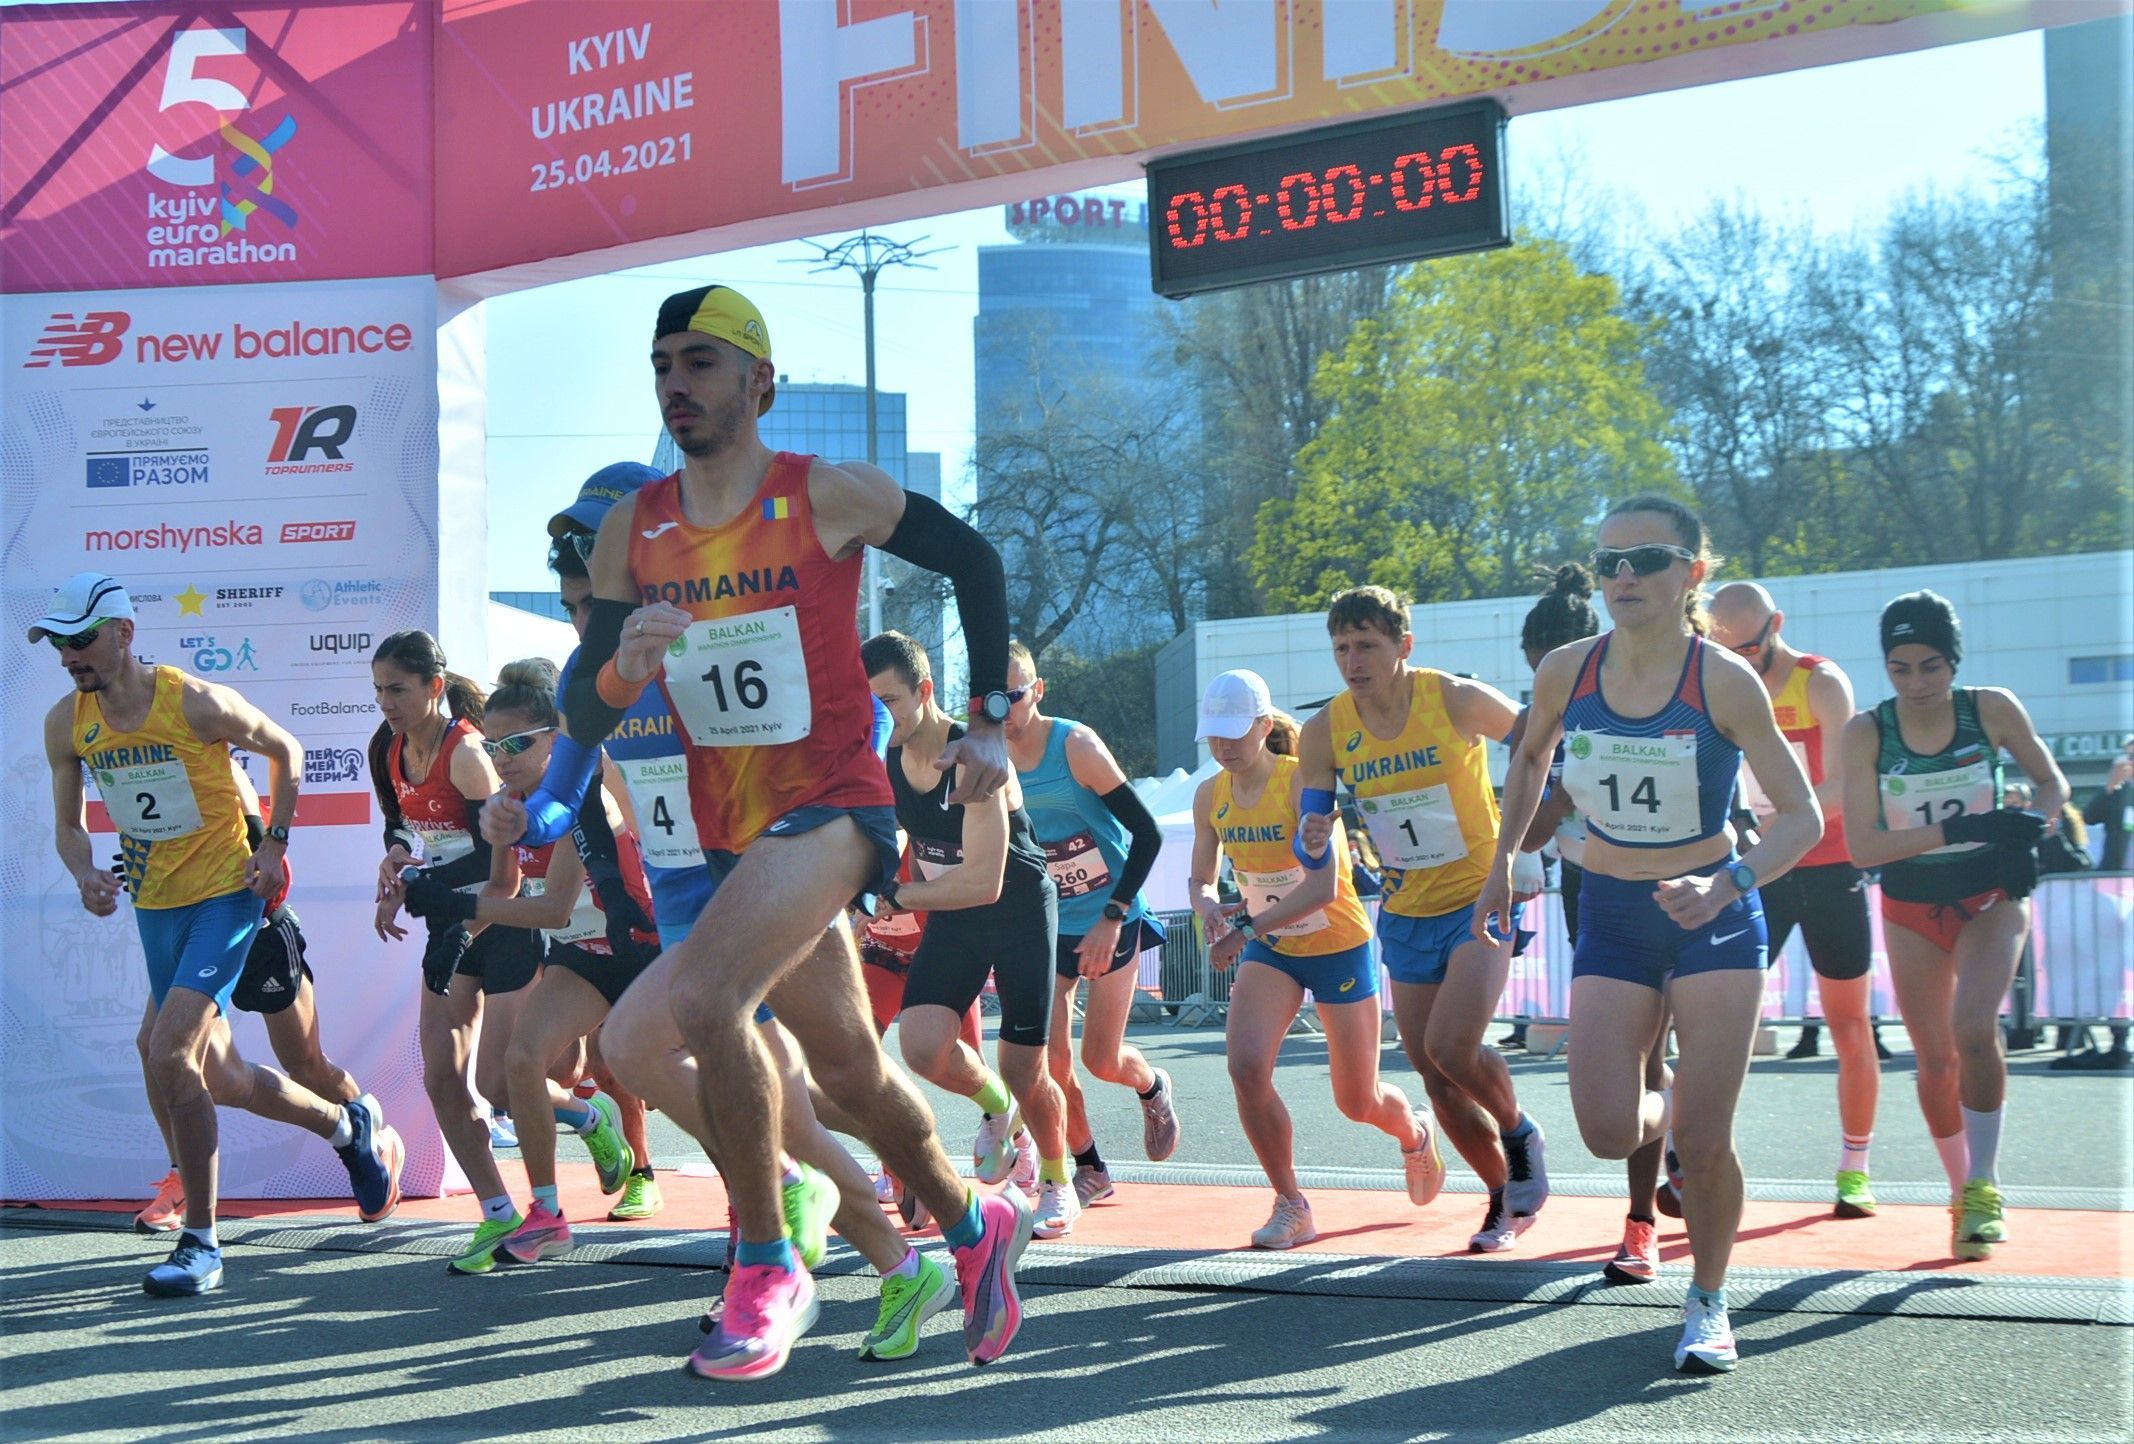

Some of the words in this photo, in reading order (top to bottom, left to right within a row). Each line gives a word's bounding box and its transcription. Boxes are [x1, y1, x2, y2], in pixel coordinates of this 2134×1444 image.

[568, 22, 652, 76] KYIV
[531, 71, 694, 140] UKRAINE
[530, 132, 692, 192] 25.04.2021
[148, 190, 217, 224] kyiv
[1166, 143, 1484, 249] 00:00:00
[1012, 196, 1126, 229] SPORT
[147, 223, 220, 246] euro
[148, 238, 297, 268] marathon
[136, 331, 223, 364] new
[233, 320, 413, 360] balance
[103, 416, 190, 428] ПРЕДСТАВНИЦТВО
[132, 453, 210, 468] ПРЯМУЄМО
[132, 466, 209, 486] РАЗОМ
[85, 520, 264, 554] morshynska
[283, 522, 354, 541] SPORT
[216, 586, 284, 600] SHERIFF
[334, 579, 382, 593] Athletic
[642, 565, 800, 606] ROMANIA
[334, 594, 382, 606] Events
[708, 620, 766, 641] BALKAN
[310, 632, 371, 655] uquip
[193, 647, 233, 673] GO
[701, 659, 769, 713] 16
[291, 701, 376, 716] FootBalance
[720, 724, 739, 736] April
[740, 723, 760, 735] 2021
[761, 721, 783, 734] Kyiv
[92, 744, 178, 770] UKRAINE
[304, 747, 343, 761] ПЕЙС
[1612, 743, 1667, 758] BALKAN
[127, 768, 166, 780] BALKAN
[304, 759, 336, 772] МЕЙ
[640, 763, 683, 778] BALKAN
[1353, 745, 1442, 783] UKRAINE
[304, 771, 343, 784] КЕРИ
[1390, 793, 1429, 808] BALKAN
[1599, 773, 1661, 814] 14
[135, 791, 162, 820] 2
[652, 795, 676, 837] 4
[1221, 824, 1285, 844] UKRAINE
[1399, 818, 1420, 847] 1
[1626, 823, 1647, 832] 2021
[1068, 838, 1086, 852] 42
